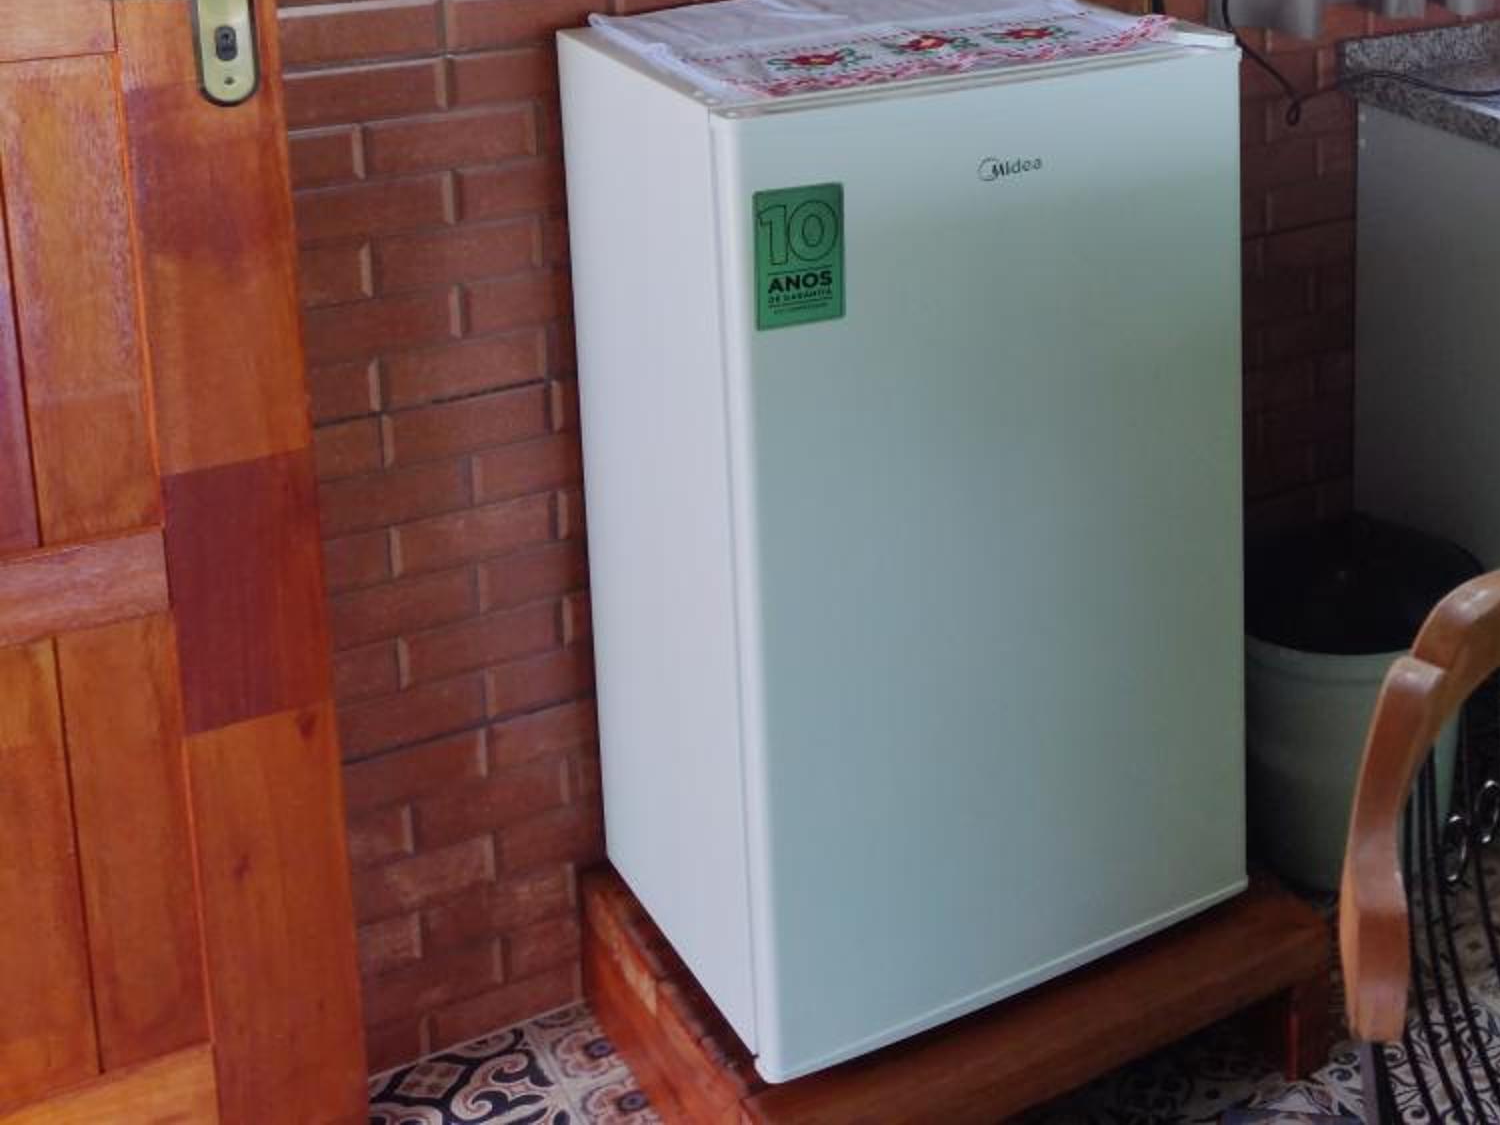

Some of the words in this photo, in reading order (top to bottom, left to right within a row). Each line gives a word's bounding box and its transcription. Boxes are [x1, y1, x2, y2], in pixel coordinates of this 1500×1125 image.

[979, 158, 1042, 181] Midea
[757, 200, 838, 266] 10
[767, 270, 832, 294] ANOS
